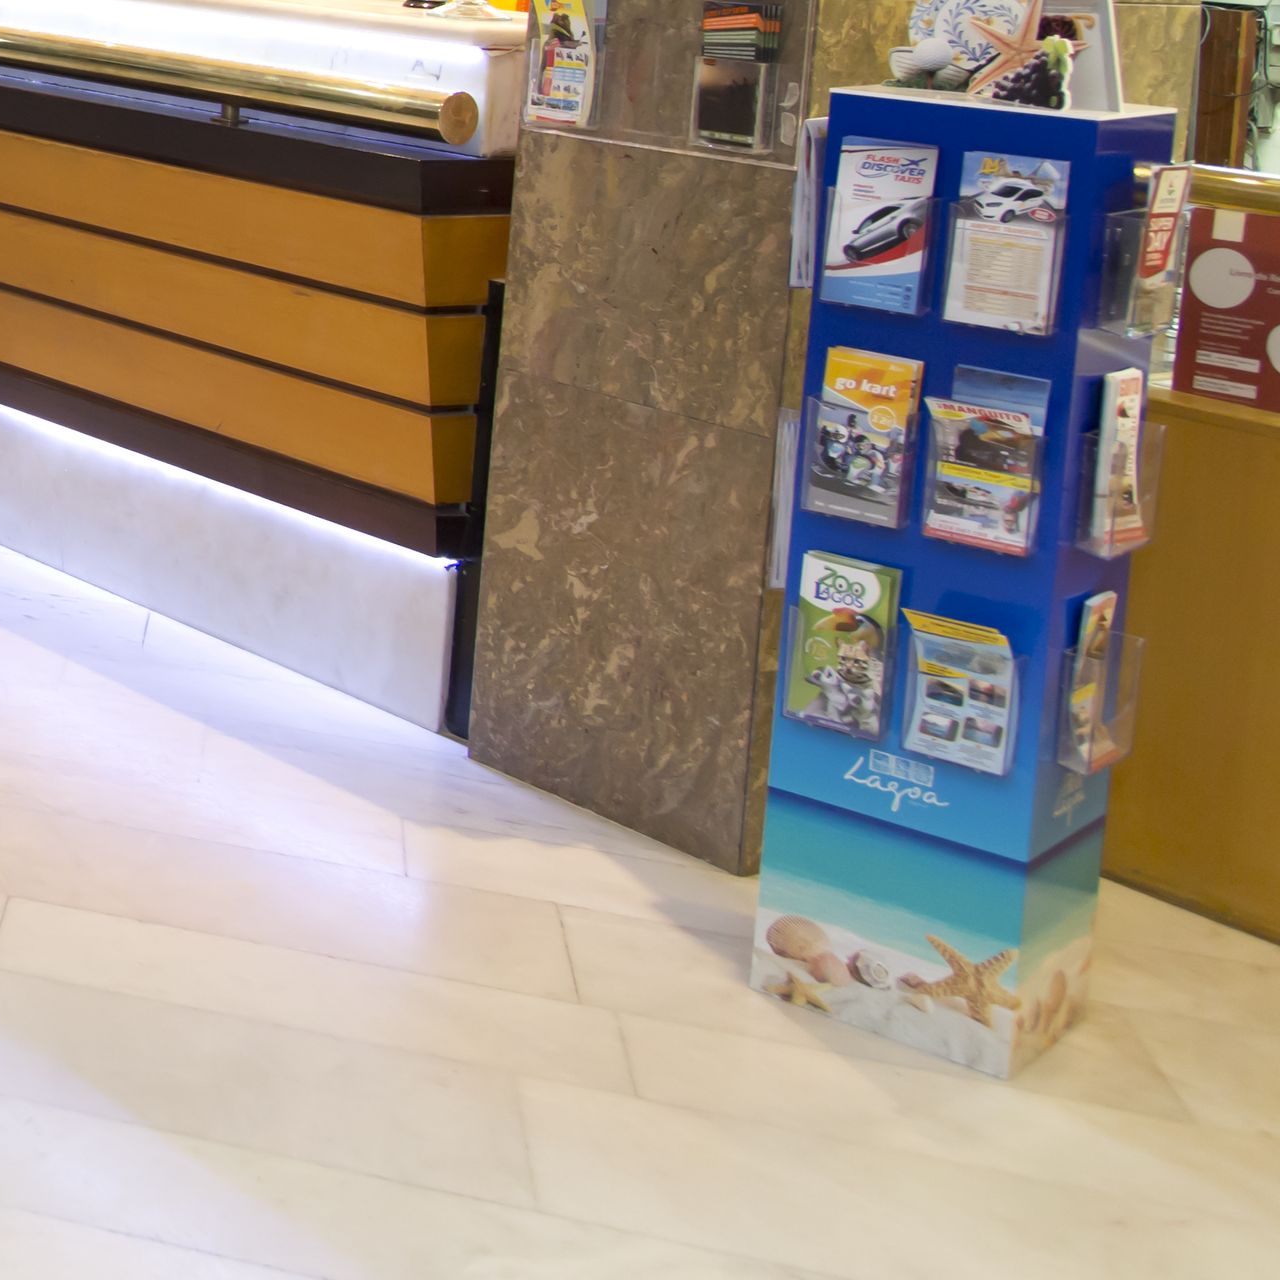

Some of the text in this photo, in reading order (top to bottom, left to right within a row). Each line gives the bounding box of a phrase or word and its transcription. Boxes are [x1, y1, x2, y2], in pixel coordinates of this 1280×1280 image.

[865, 154, 901, 165] FLASH
[861, 161, 926, 177] DISCOVER
[894, 174, 924, 185] TAXIS
[834, 377, 897, 398] go kart
[819, 565, 866, 600] ZOO
[843, 757, 950, 812] Lagoa
